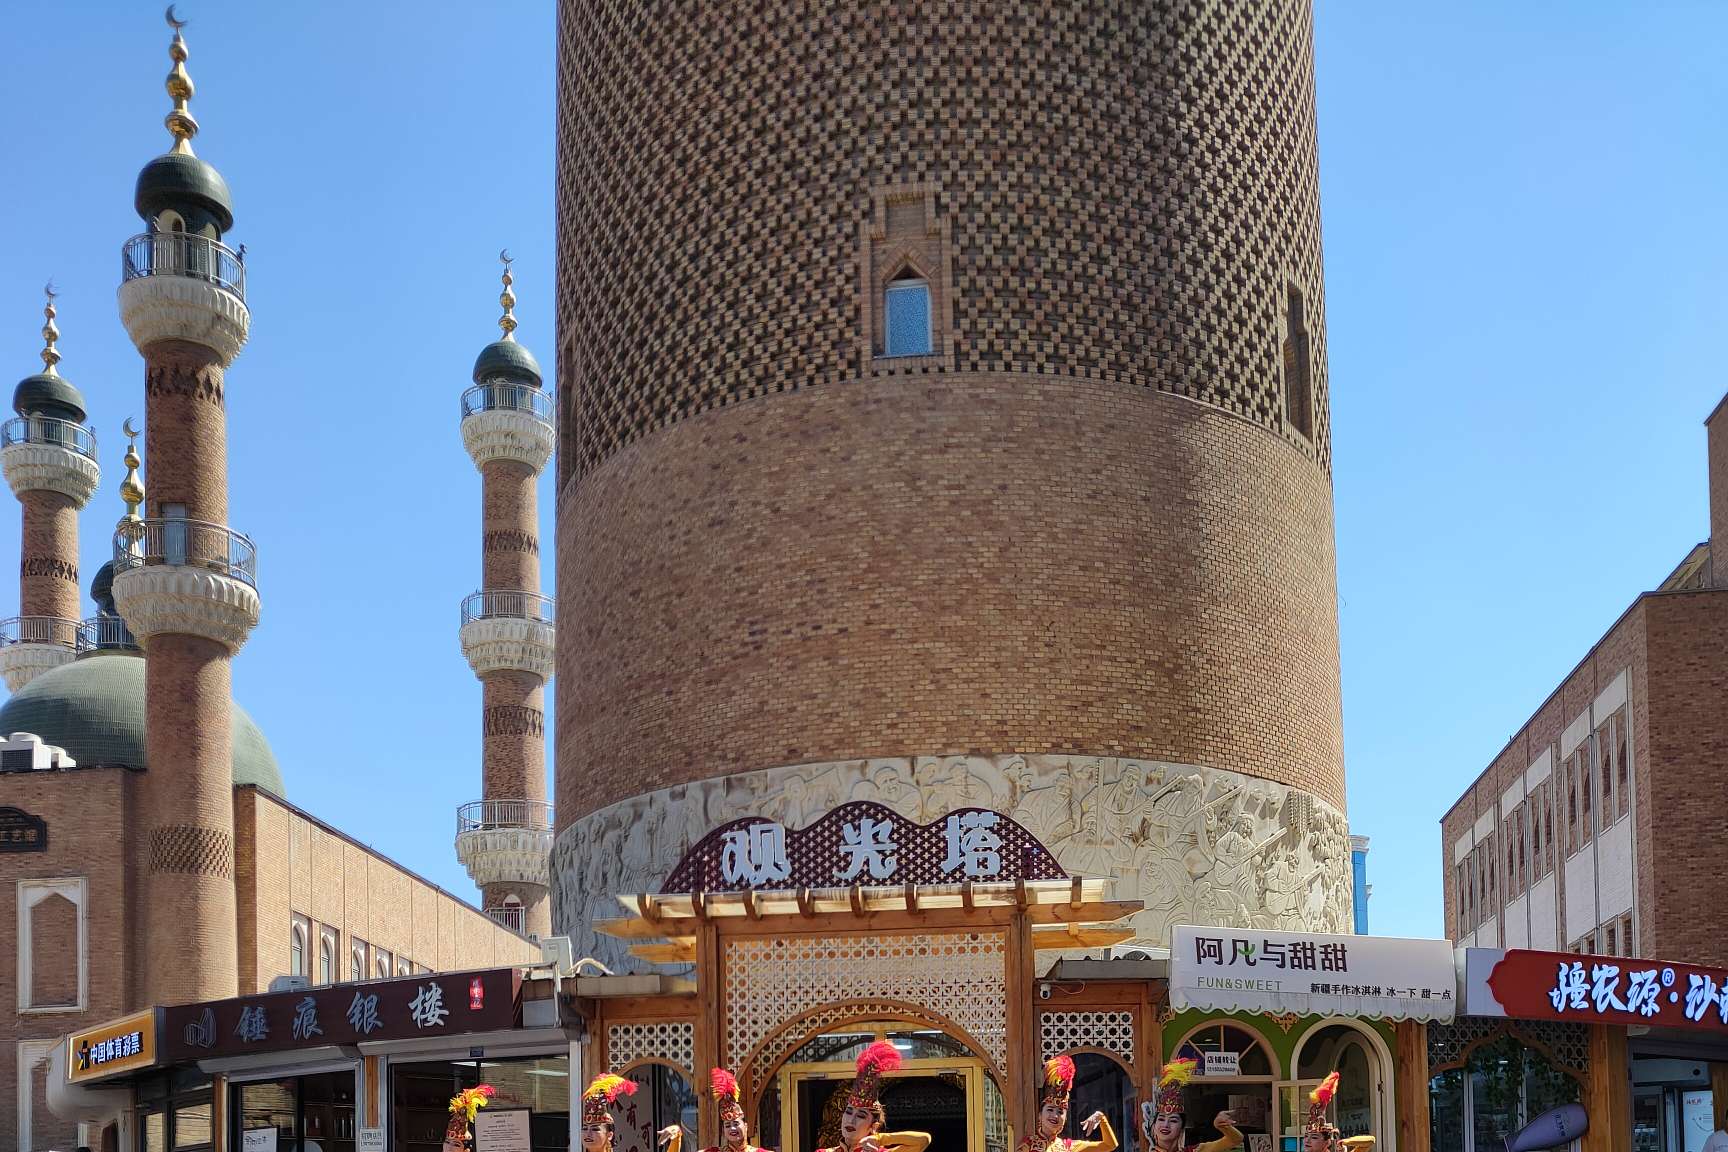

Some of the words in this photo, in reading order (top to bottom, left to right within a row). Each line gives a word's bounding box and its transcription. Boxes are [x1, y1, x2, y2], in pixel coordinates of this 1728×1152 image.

[721, 811, 1004, 885] 观光塔
[1195, 936, 1348, 973] 阿凡与甜甜
[1197, 976, 1283, 991] FUN&SWEET
[1310, 982, 1382, 997] 新疆手作冰淇淋
[1386, 986, 1417, 999] 冰一下
[1421, 988, 1452, 1000] 甜一点
[90, 1031, 141, 1065] 中国体育彩票
